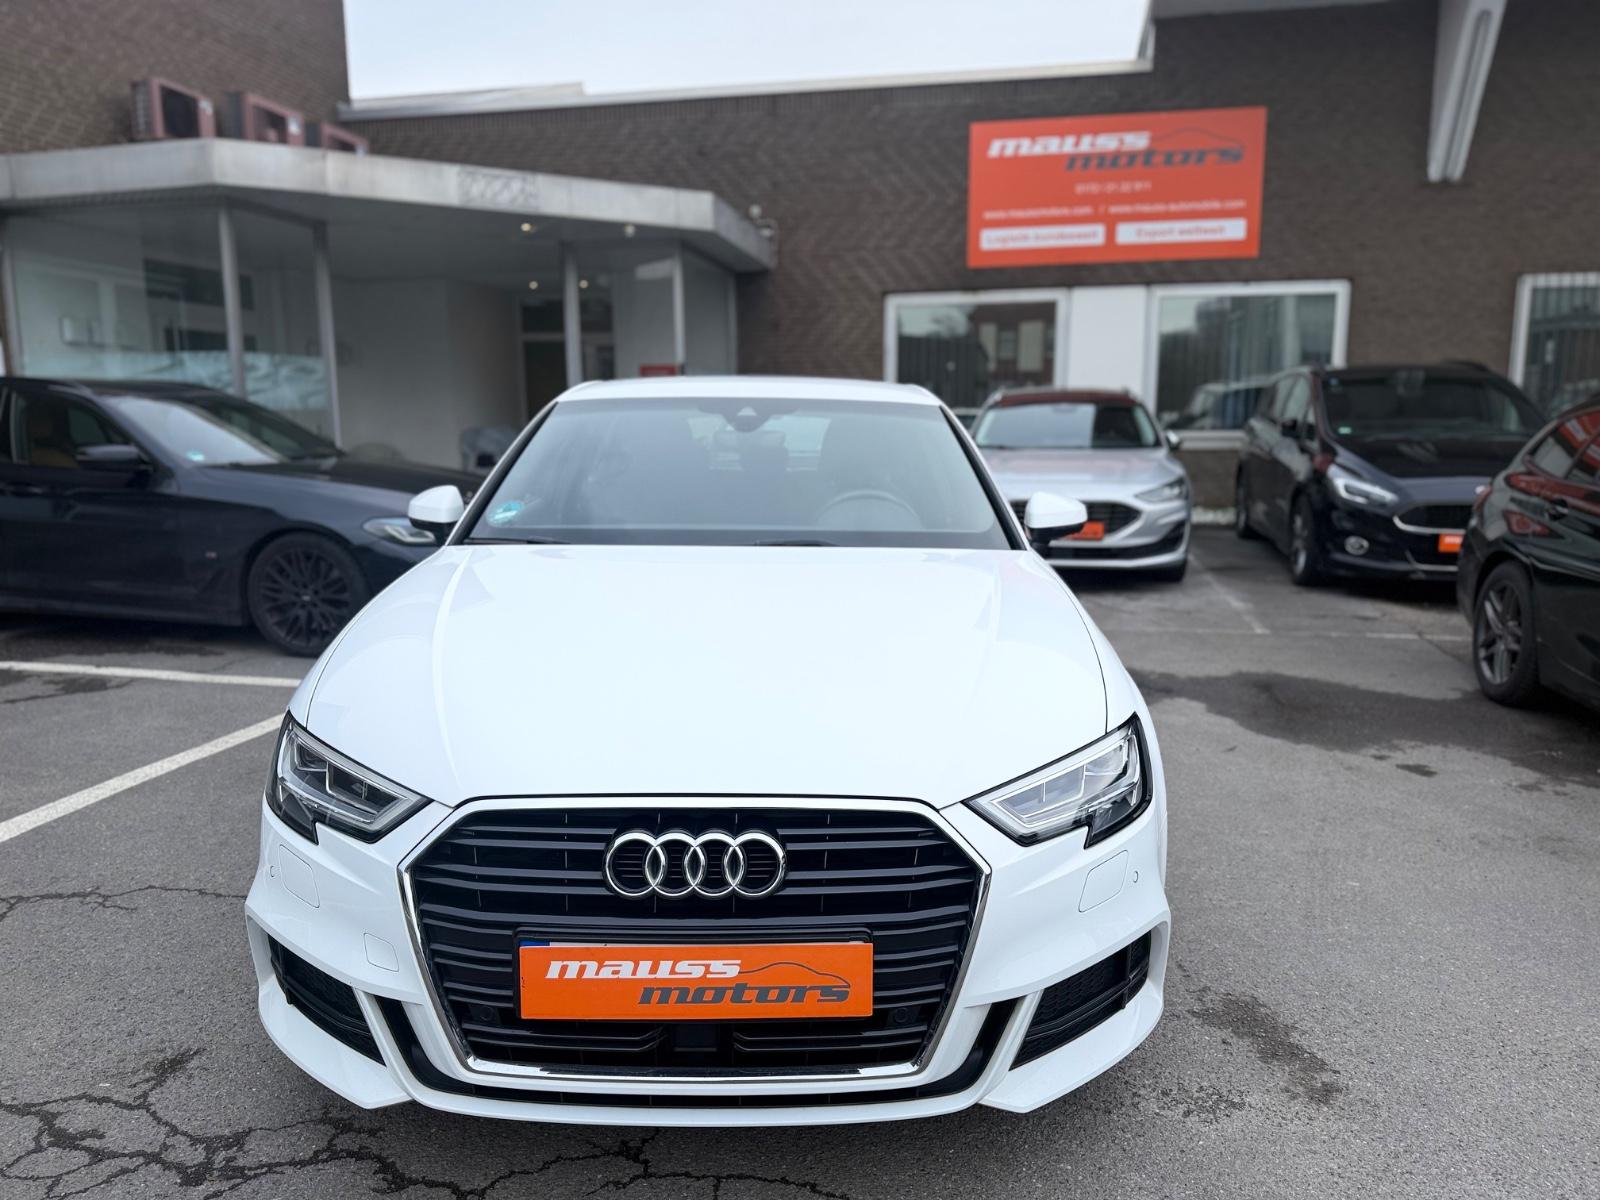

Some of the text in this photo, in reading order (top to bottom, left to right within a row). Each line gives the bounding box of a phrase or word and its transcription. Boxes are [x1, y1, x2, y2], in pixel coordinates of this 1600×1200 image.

[987, 131, 1150, 157] mauss
[1065, 148, 1243, 171] motors
[545, 959, 741, 979] mauss
[638, 982, 850, 1005] motors
